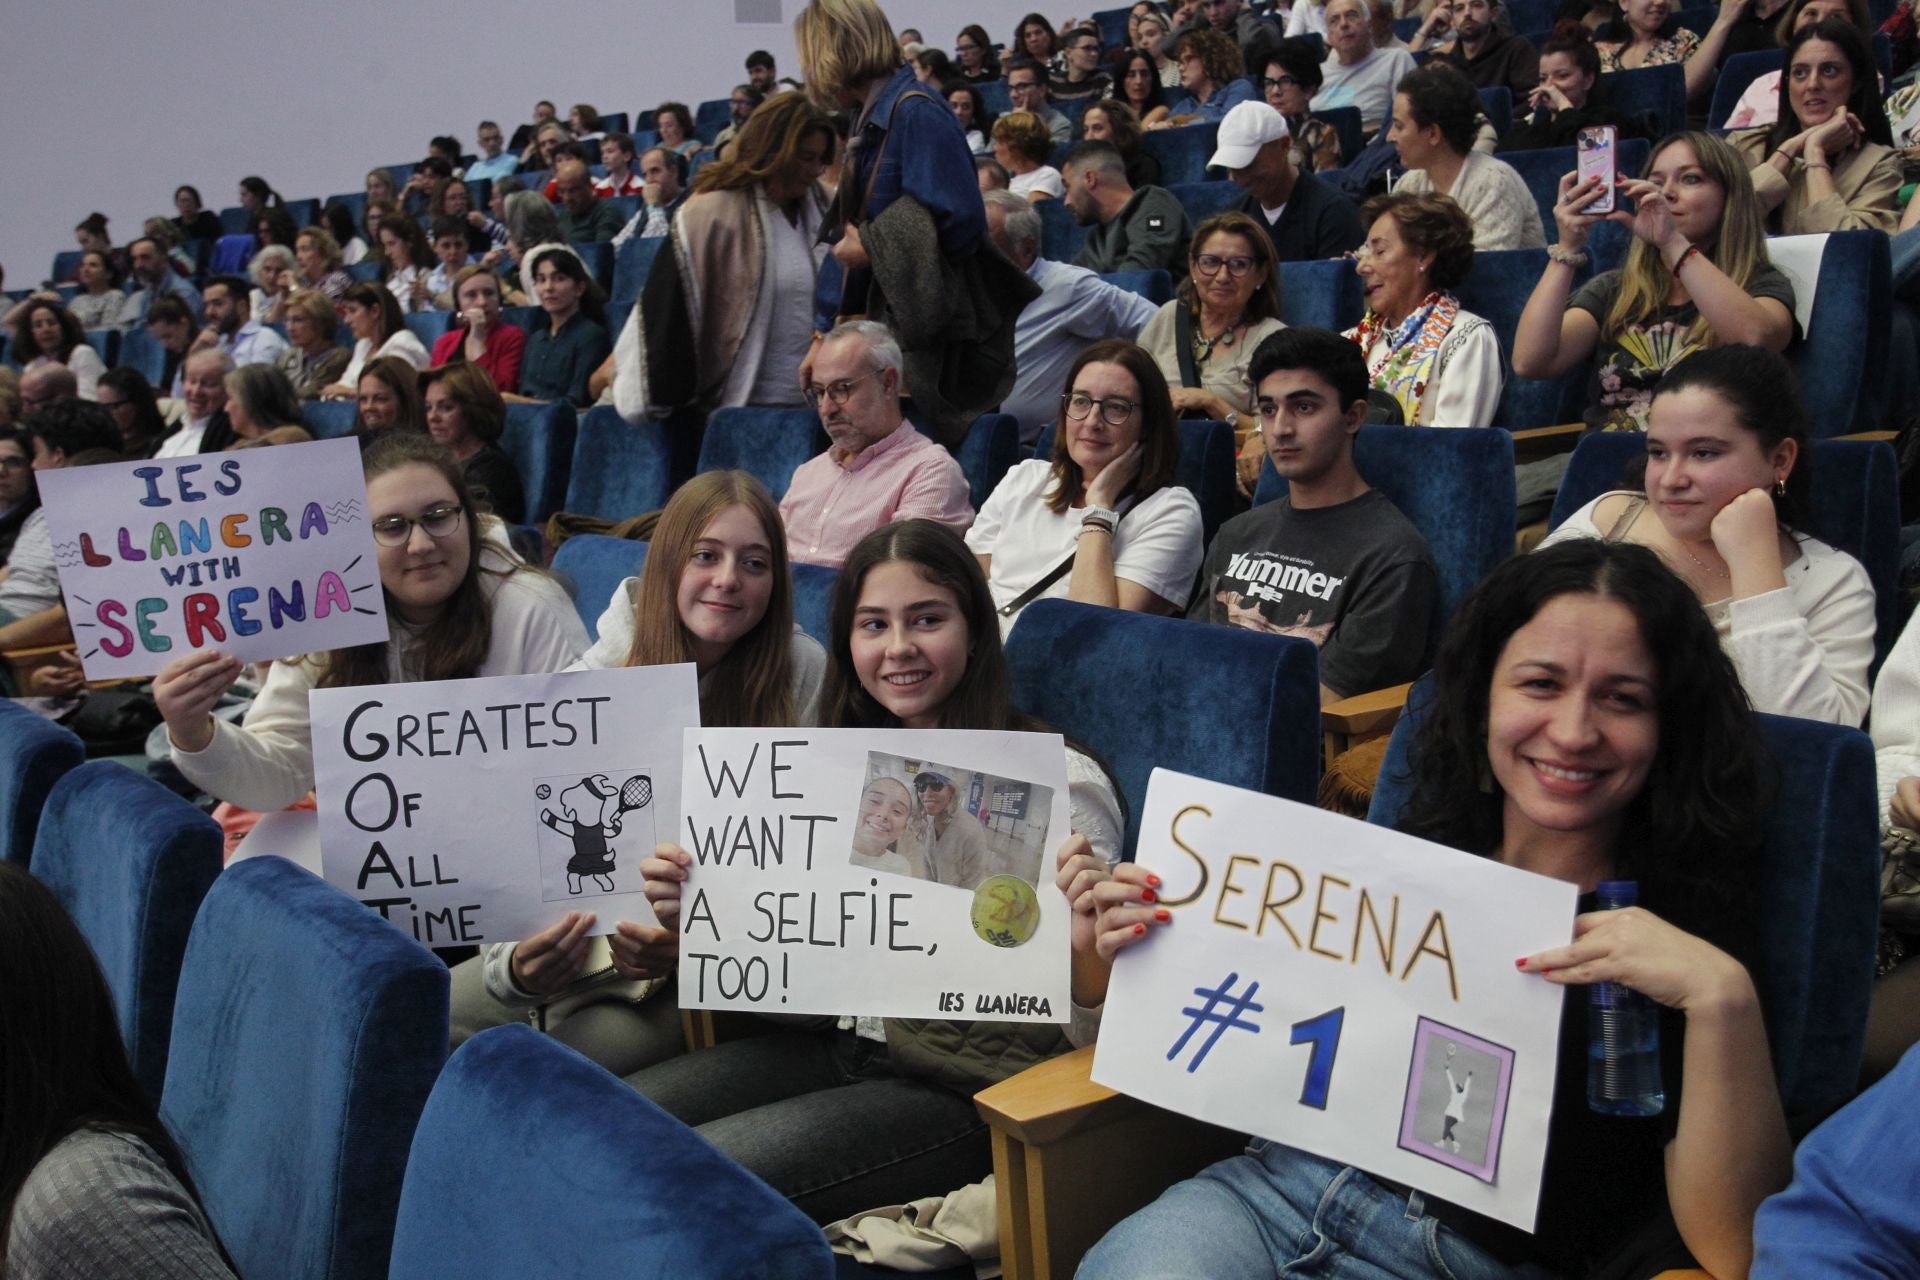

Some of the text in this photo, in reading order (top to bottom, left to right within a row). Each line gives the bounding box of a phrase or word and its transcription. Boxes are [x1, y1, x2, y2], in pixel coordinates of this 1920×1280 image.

[133, 460, 242, 507] IES
[79, 502, 328, 567] LLANERA
[160, 556, 240, 587] WITH
[97, 571, 351, 658] SERENA
[343, 696, 611, 762] GREATEST
[699, 741, 809, 799] WE
[357, 840, 459, 890] ALL
[688, 815, 837, 870] WANT
[684, 888, 720, 941] A
[1157, 804, 1459, 1002] SERENA
[688, 952, 789, 1003] TOO!
[938, 991, 1052, 1017] IES LLANERA
